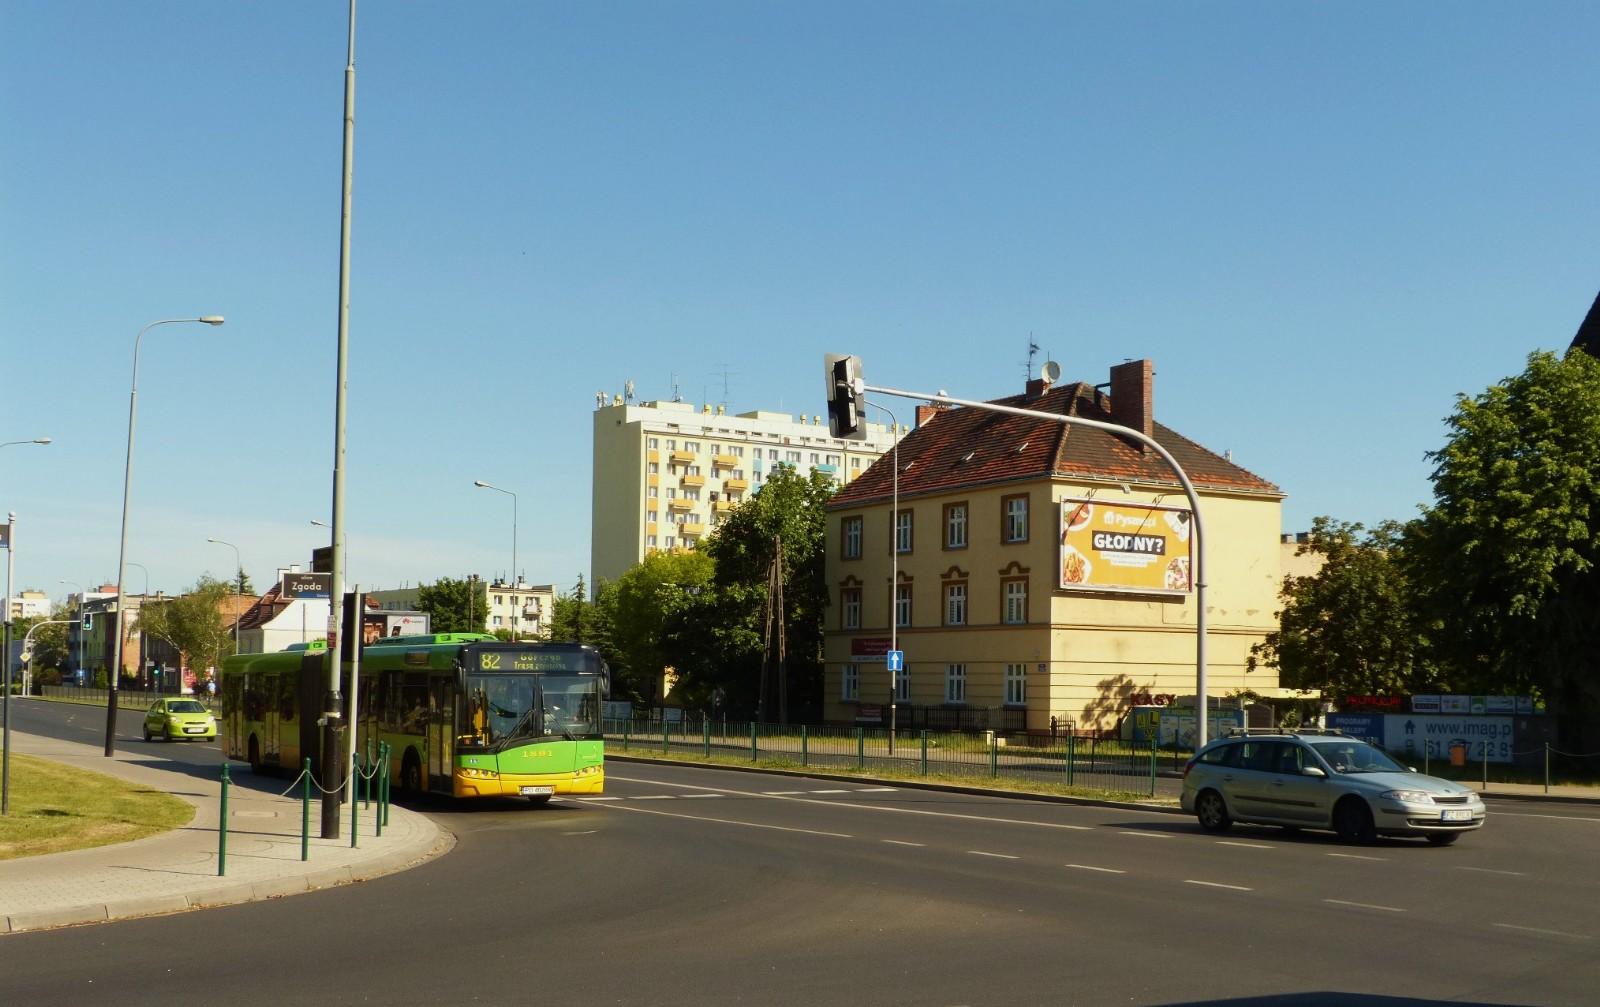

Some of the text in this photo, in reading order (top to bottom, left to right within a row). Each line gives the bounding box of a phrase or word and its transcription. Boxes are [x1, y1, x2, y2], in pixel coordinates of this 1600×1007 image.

[1094, 534, 1163, 553] GŁODNY?
[291, 581, 322, 593] Zgoda
[481, 654, 501, 669] 82
